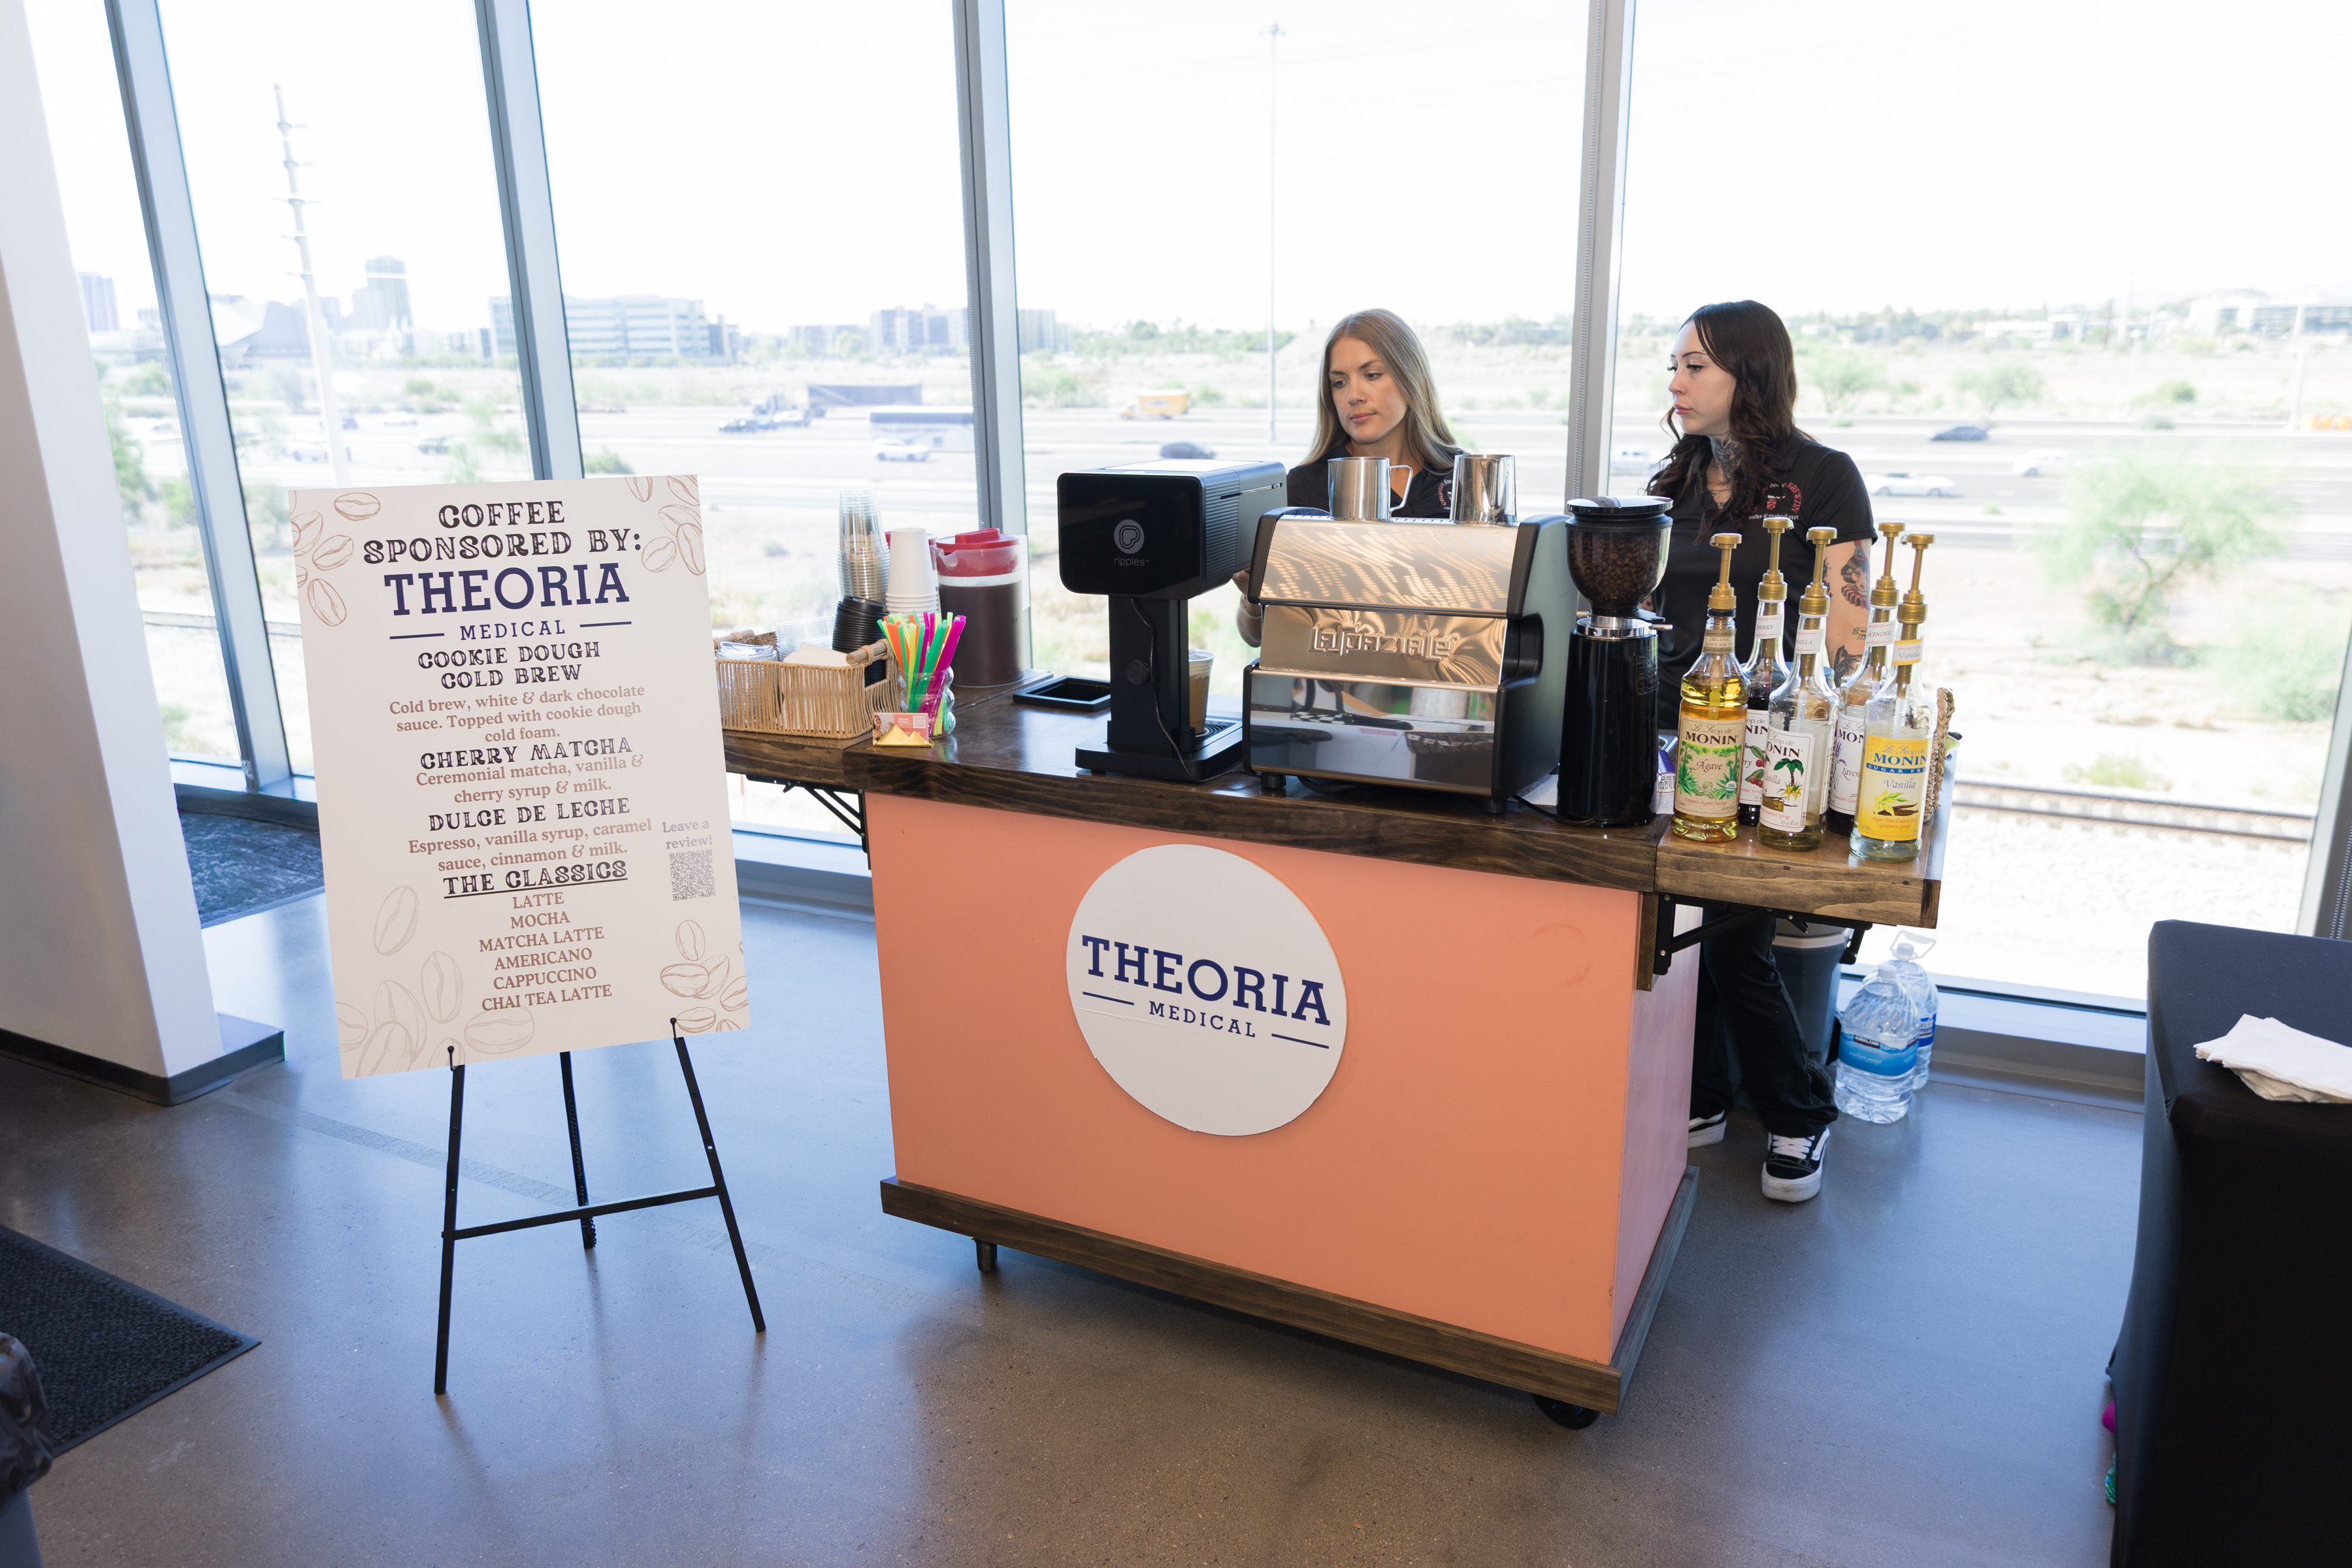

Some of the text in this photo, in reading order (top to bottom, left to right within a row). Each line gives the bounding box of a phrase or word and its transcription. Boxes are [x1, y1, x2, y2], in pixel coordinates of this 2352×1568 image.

[1787, 482, 1802, 513] BREWZIN
[439, 501, 564, 529] COFFEE
[364, 529, 642, 564] SPONSORED BY:
[1114, 557, 1145, 566] ripples
[384, 563, 629, 615] THEORIA
[460, 620, 566, 640] MEDICAL
[418, 642, 600, 668] COOKIE DOUGH
[1898, 650, 1920, 659] Vanilla
[442, 664, 581, 689] COLD BREW
[390, 686, 644, 714] Cold brew, white & dark chocolate
[397, 702, 641, 731] sauce. Topped with cookie dough
[485, 727, 559, 742] cold foam.
[1686, 732, 1737, 745] MONIN
[1746, 725, 1768, 735] NIN
[421, 738, 632, 769] CHERRY MATCHA
[1767, 742, 1800, 757] ONIN
[417, 755, 644, 785] Ceremonial matcha, vanilla &
[1689, 759, 1723, 772] Agave
[1868, 764, 1903, 774] SUGAR
[455, 778, 612, 803] cherry syrup & milk.
[1884, 777, 1916, 789] Vanilla
[429, 798, 629, 831] DULCE DE LECHE
[409, 819, 651, 855] Espresso, vanilla syrup, caramel
[662, 822, 698, 833] Leave
[666, 834, 712, 849] review!
[438, 841, 627, 871] sauce, cinnamon & milk.
[444, 860, 627, 896] THE CLASSICS
[513, 892, 564, 908] LATTE
[510, 911, 570, 929] MOCHA
[480, 927, 604, 952] MATCHA LATTE
[495, 948, 592, 970] AMERICANO
[494, 967, 596, 989] CAPPUCCINO
[1082, 934, 1331, 1026] THEORIA
[482, 985, 612, 1011] CHAI TEA LATTE
[1149, 1001, 1256, 1037] MEDICAL
